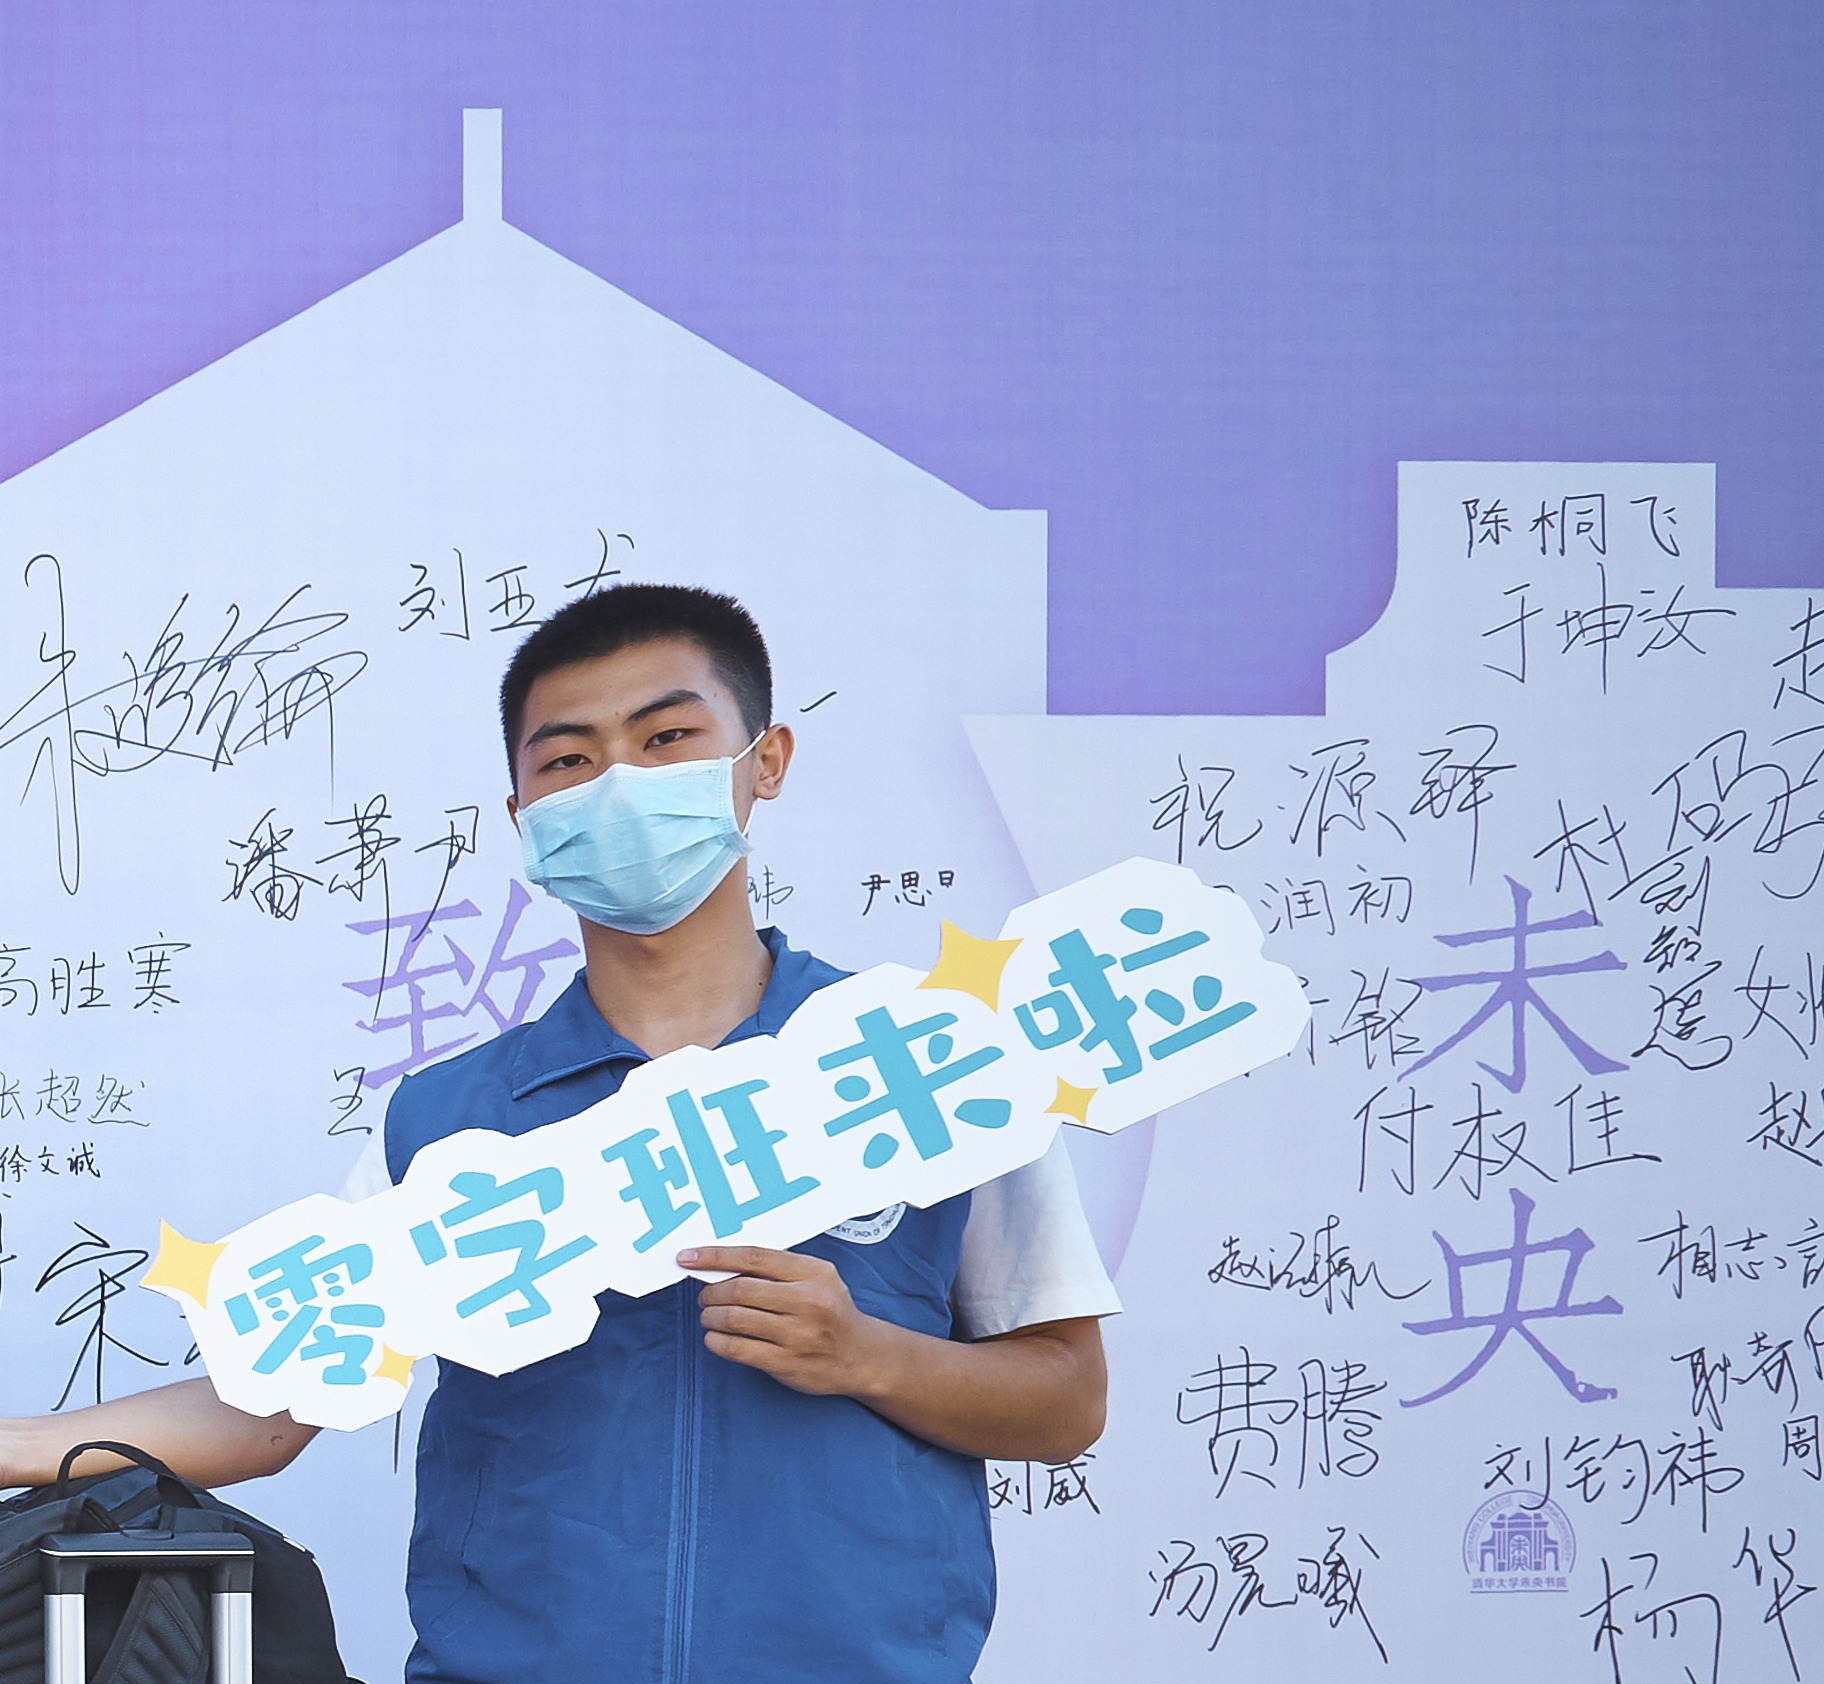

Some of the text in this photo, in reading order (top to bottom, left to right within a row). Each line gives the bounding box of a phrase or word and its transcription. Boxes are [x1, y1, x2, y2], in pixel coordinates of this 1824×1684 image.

[1462, 494, 1680, 558] 陈桐飞
[1214, 864, 1413, 936] 润初
[222, 908, 1257, 1385] 零字班来啦
[1395, 874, 1630, 1408] 未央
[1177, 1346, 1388, 1499] 费腾
